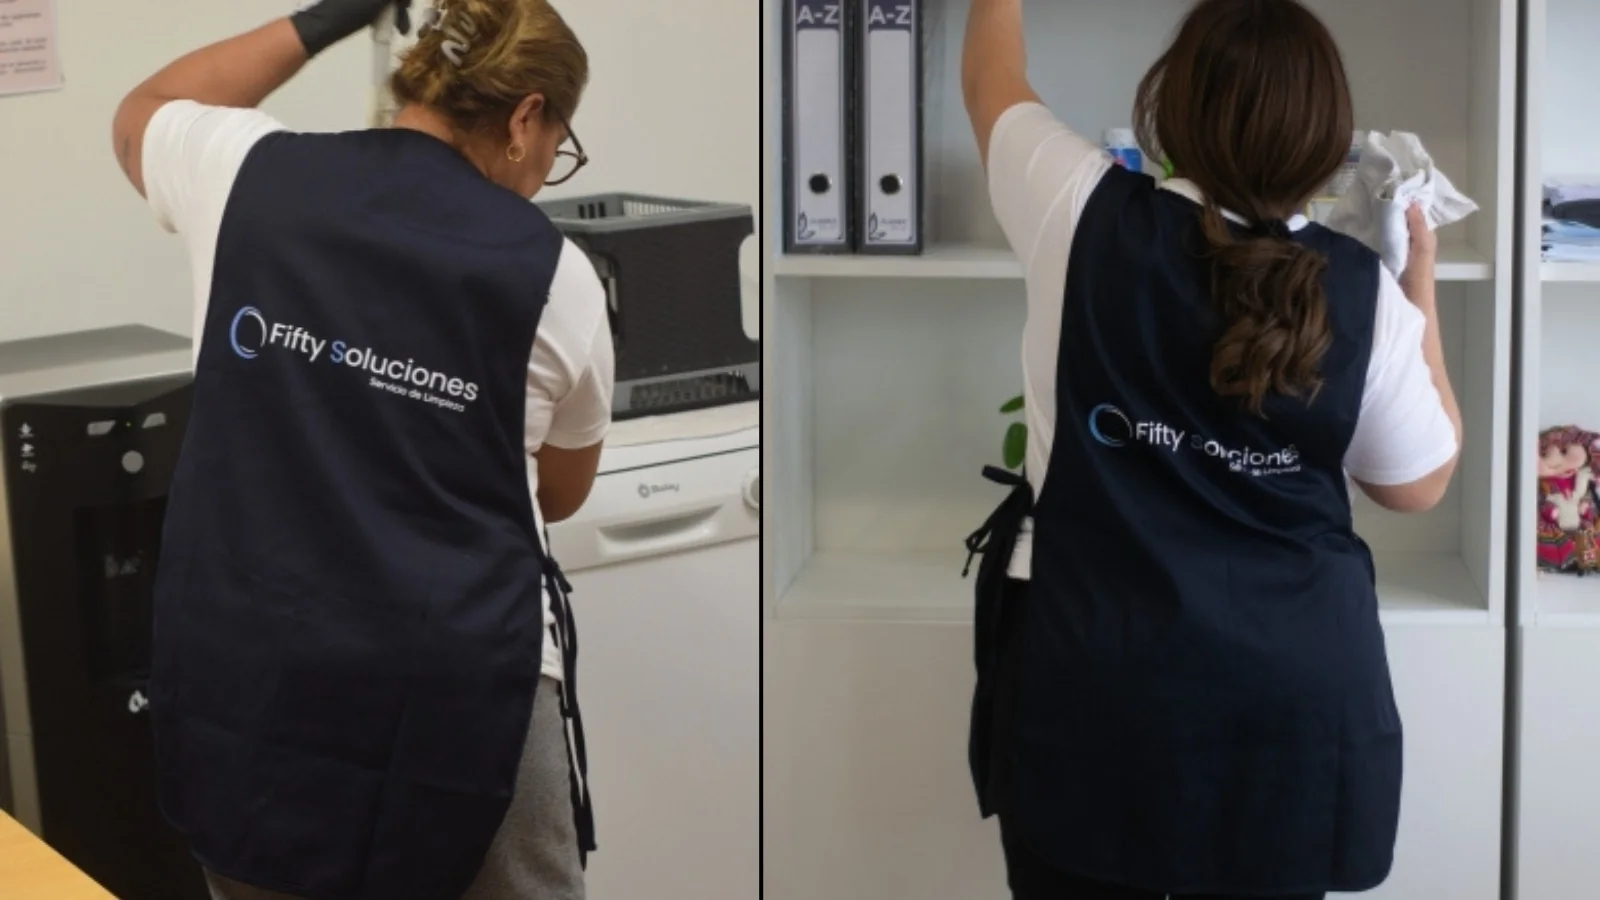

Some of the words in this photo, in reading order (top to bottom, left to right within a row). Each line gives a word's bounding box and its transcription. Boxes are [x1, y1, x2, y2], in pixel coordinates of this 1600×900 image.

[797, 5, 839, 24] A-Z
[869, 5, 911, 24] A-Z
[270, 323, 326, 362] Fifty
[330, 340, 479, 401] Soluciones
[369, 376, 407, 395] Servicio
[408, 389, 421, 400] de
[423, 392, 465, 412] Limpieza
[1136, 421, 1185, 451] Fifty
[1191, 434, 1299, 466] Socione
